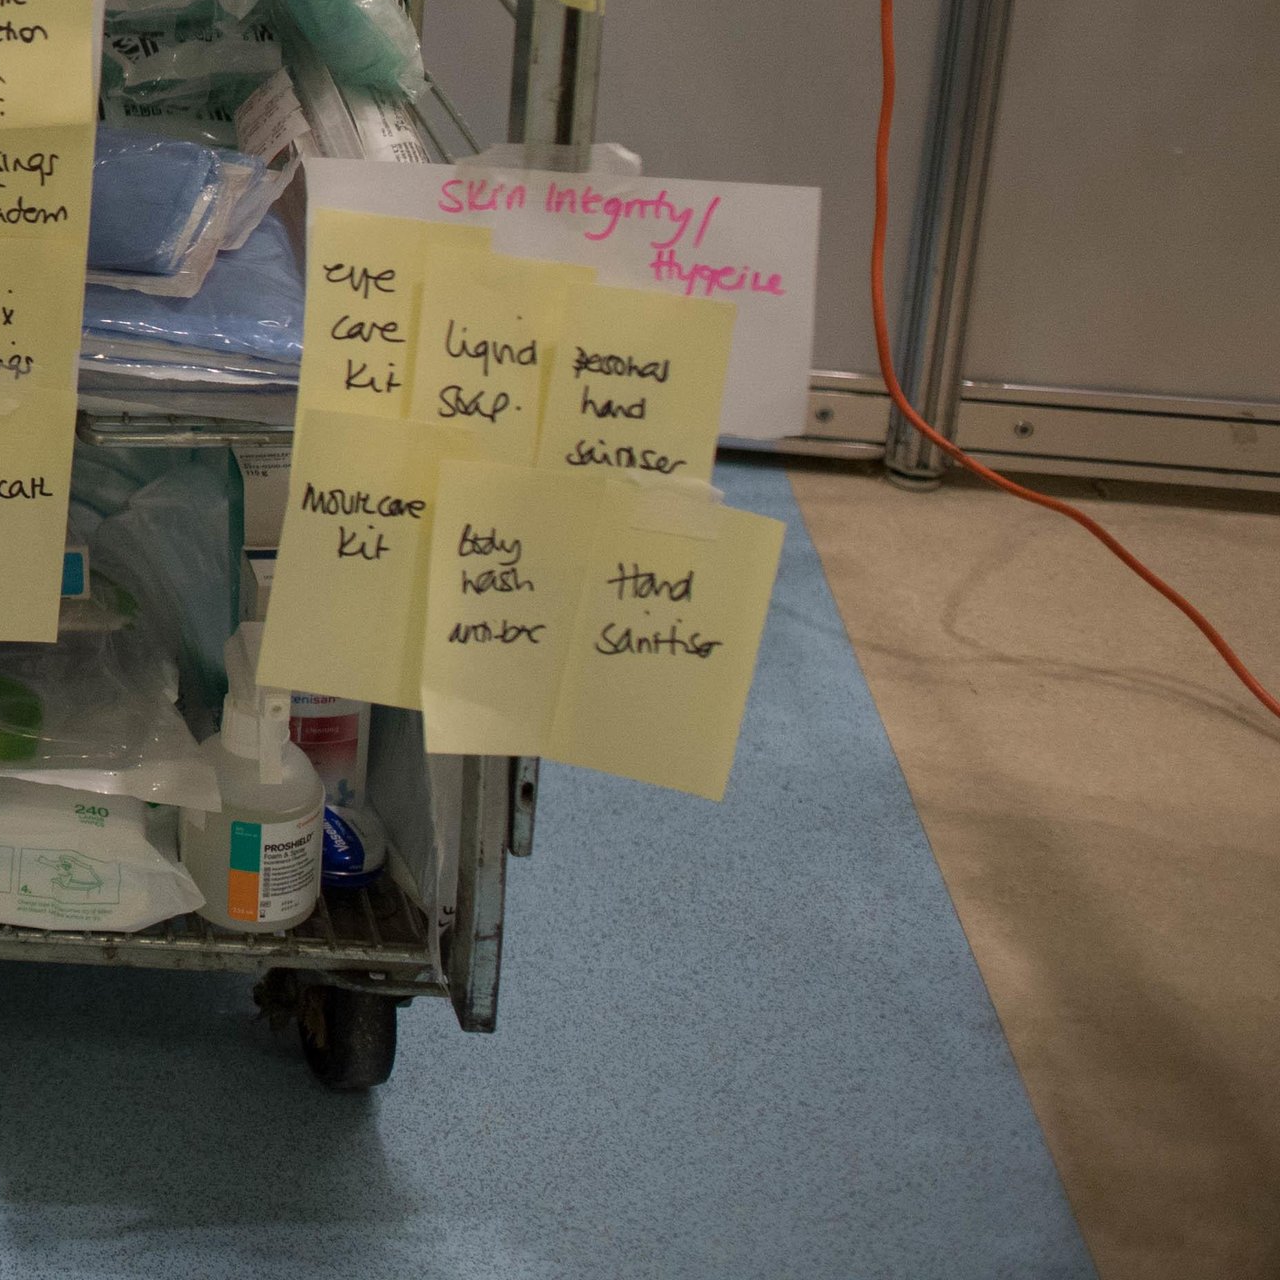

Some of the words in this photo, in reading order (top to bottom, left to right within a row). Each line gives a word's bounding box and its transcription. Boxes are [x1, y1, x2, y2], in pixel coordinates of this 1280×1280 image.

[323, 263, 396, 299] eye
[331, 315, 406, 343] care
[581, 385, 646, 420] hand
[607, 562, 694, 602] Hand
[74, 804, 110, 818] 240
